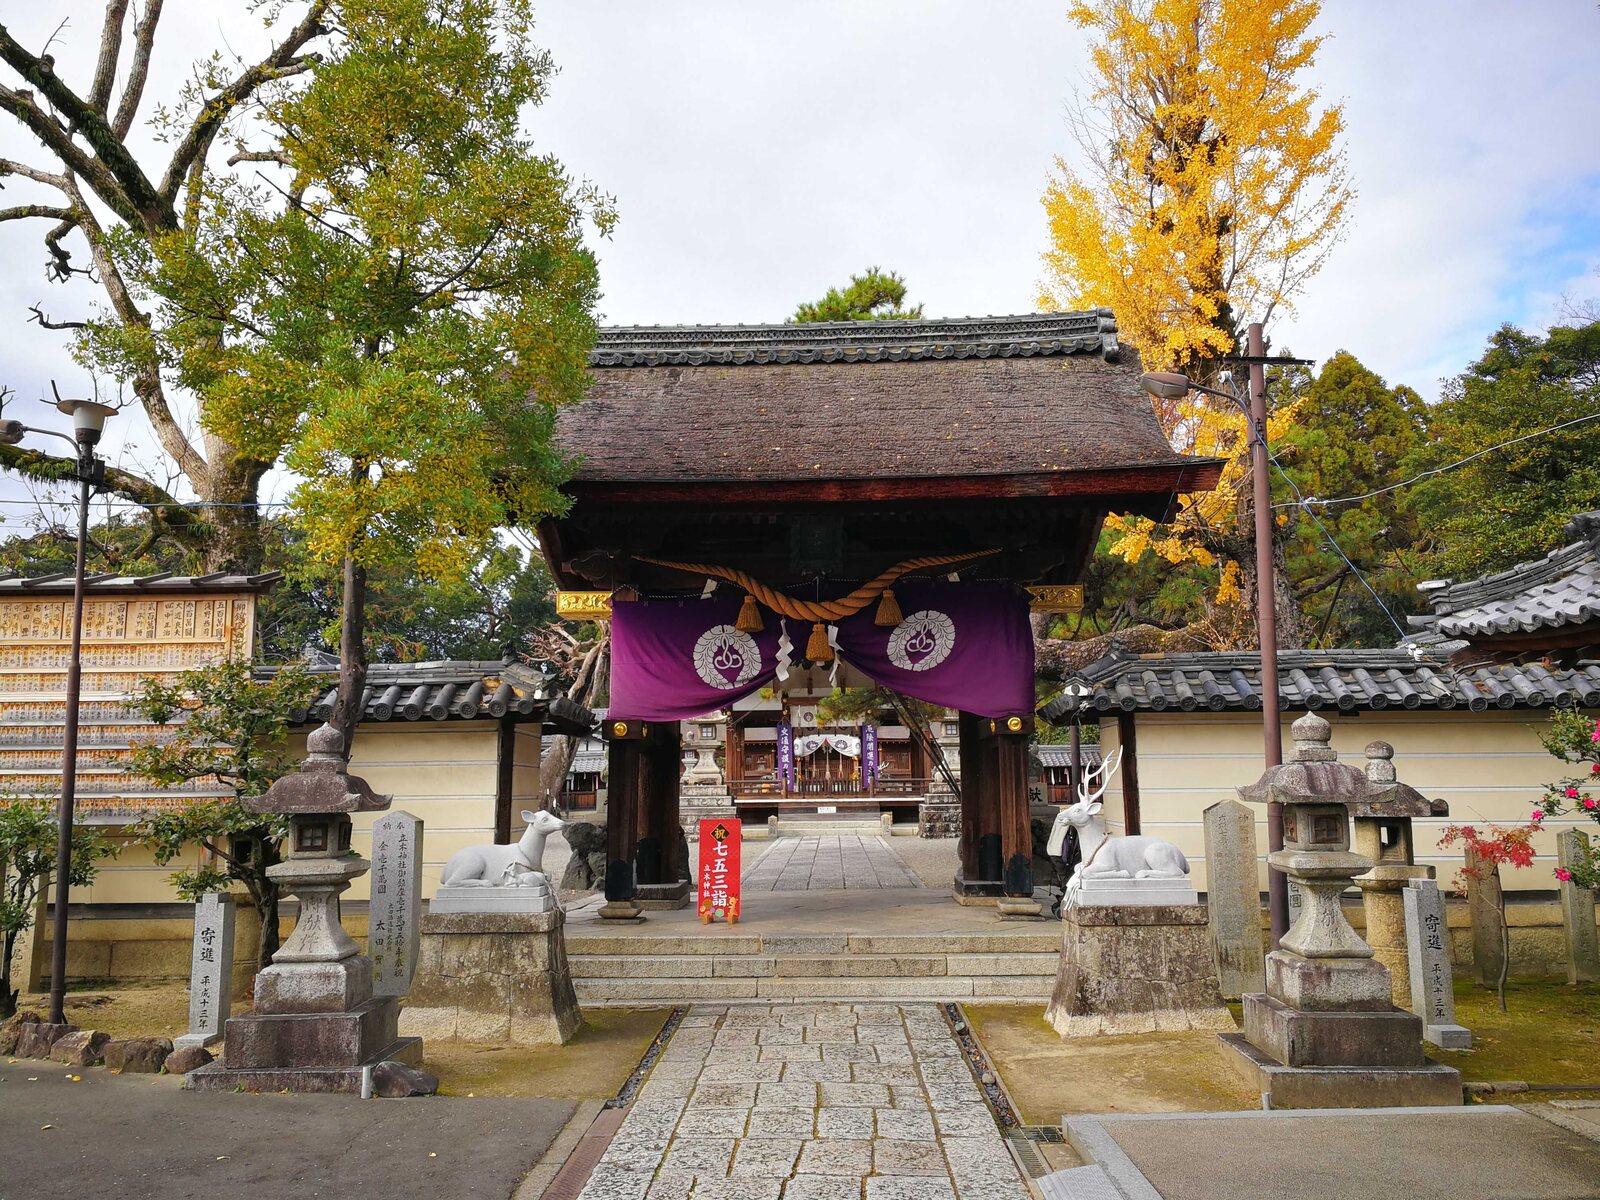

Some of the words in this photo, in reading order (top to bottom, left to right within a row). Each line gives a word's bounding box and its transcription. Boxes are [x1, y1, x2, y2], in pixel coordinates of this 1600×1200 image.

[714, 828, 726, 839] 祝
[703, 864, 711, 897] 立木神社
[711, 841, 728, 907] 七五三詣
[200, 927, 216, 963] 寄進
[1425, 914, 1443, 950] 寄進
[198, 975, 211, 1030] 平成十三年
[1431, 963, 1446, 1019] 平成十三年
